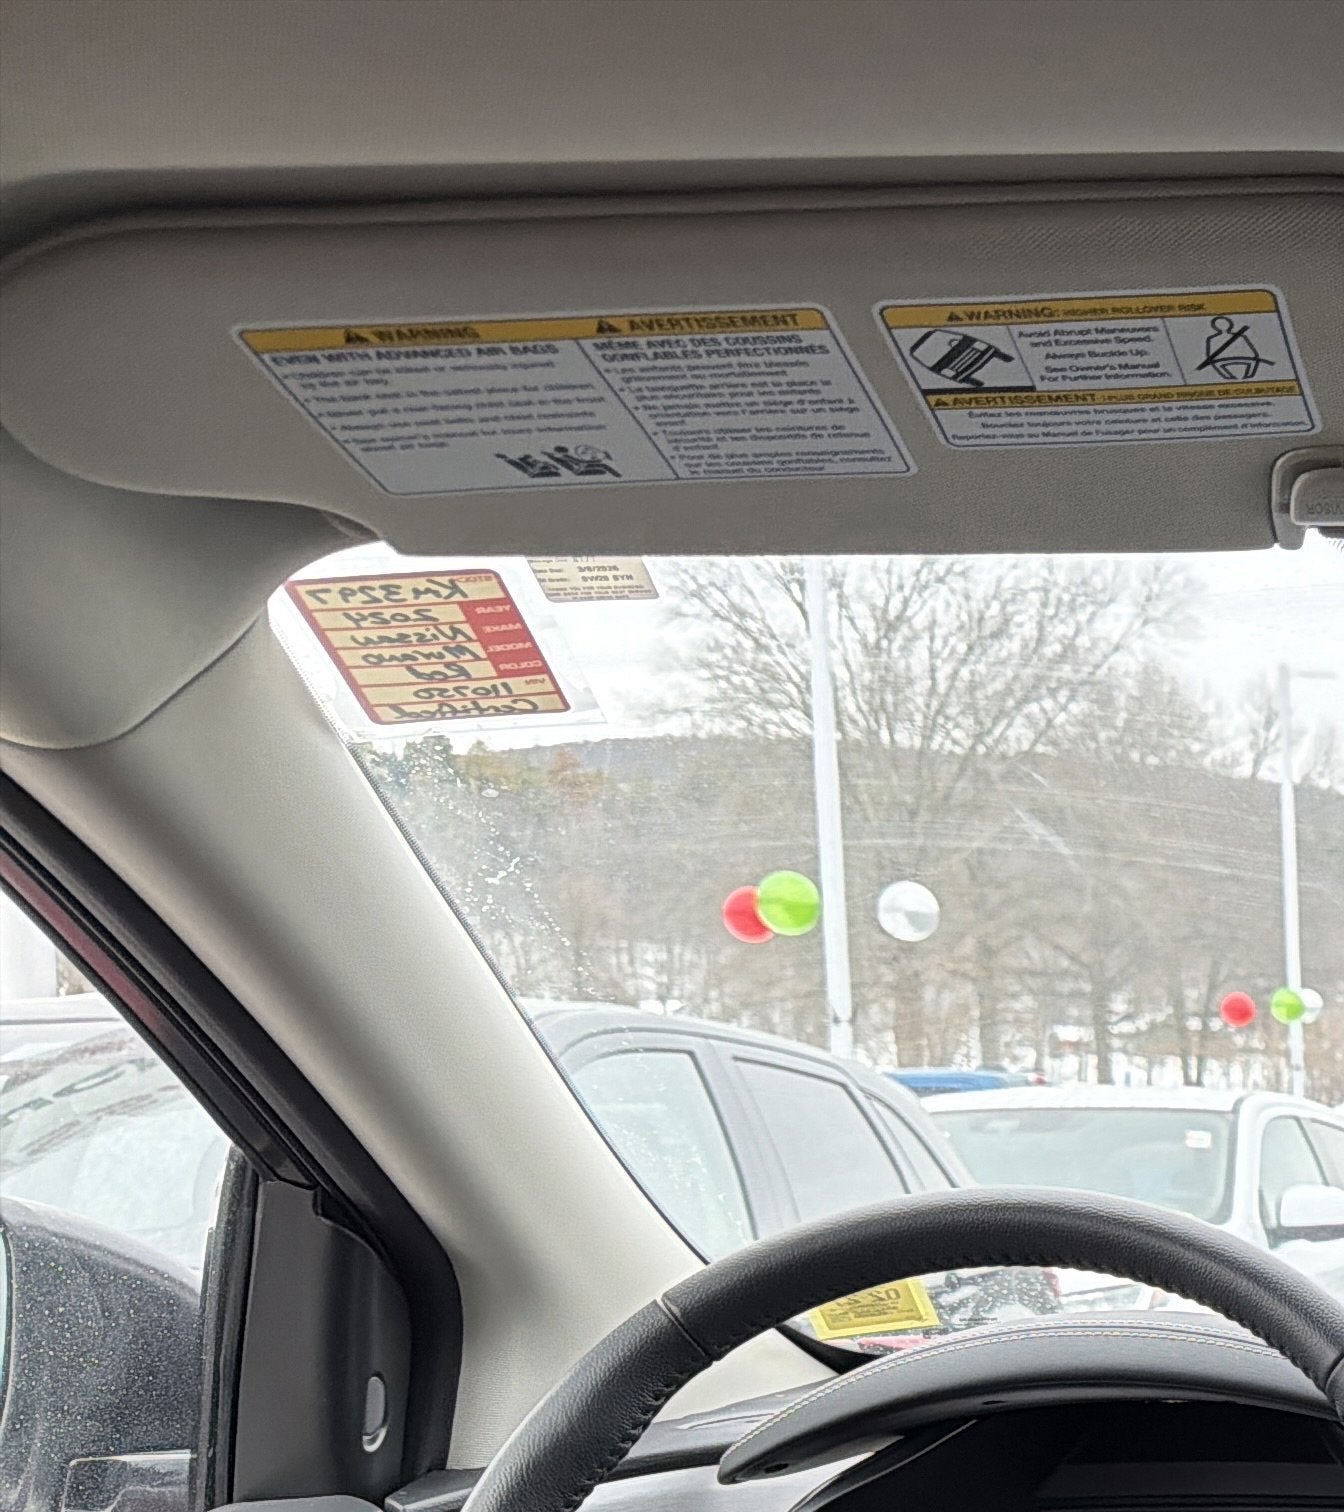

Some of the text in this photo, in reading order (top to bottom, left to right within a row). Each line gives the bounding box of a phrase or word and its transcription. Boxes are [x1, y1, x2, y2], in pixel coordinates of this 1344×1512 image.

[628, 313, 800, 333] AVERTISSEMENT
[376, 326, 480, 342] WARNING
[646, 337, 687, 350] AVEC
[1030, 338, 1051, 347] and
